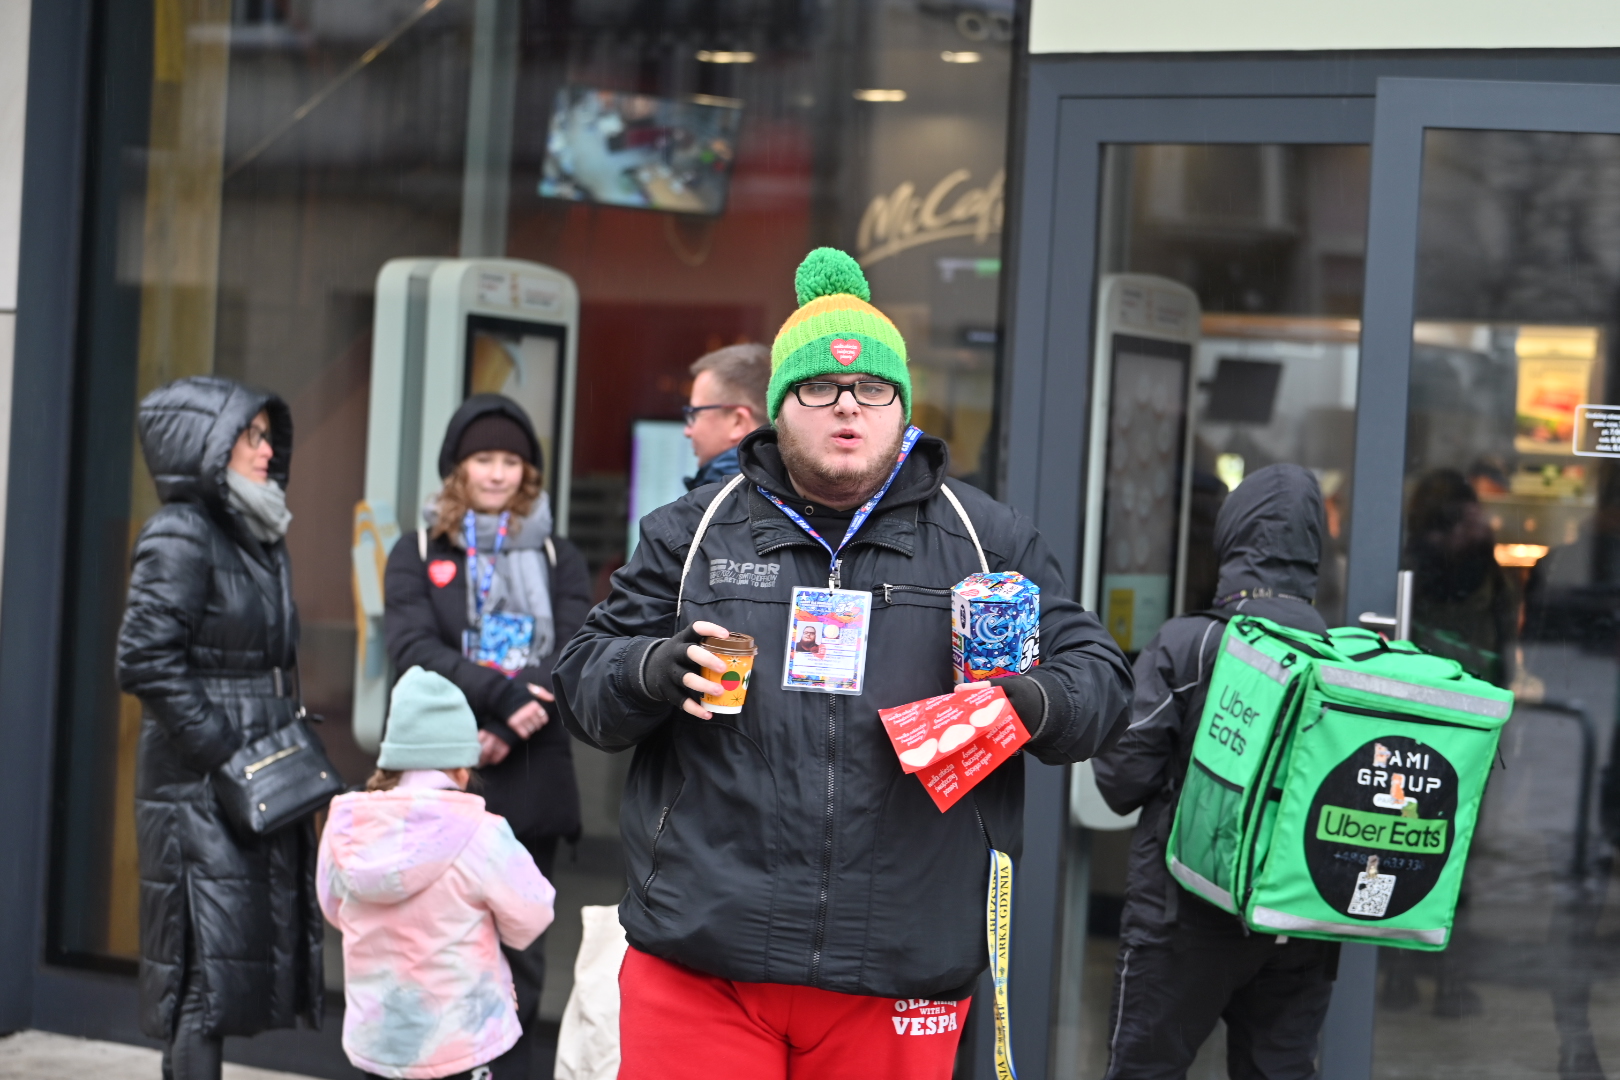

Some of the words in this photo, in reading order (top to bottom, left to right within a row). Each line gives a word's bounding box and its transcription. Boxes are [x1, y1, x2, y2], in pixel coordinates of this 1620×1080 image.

[857, 168, 1006, 250] McCaf
[1219, 684, 1261, 728] Uber
[1208, 712, 1247, 756] Eats
[1373, 745, 1430, 771] AMI
[1325, 811, 1386, 842] Uber
[1389, 821, 1441, 848] Eats
[999, 865, 1009, 919] GDYNIA
[998, 923, 1007, 959] ARKA
[892, 1012, 958, 1036] VESPA
[894, 999, 930, 1013] OLD
[919, 1007, 940, 1015] WITH
[940, 1006, 947, 1014] A
